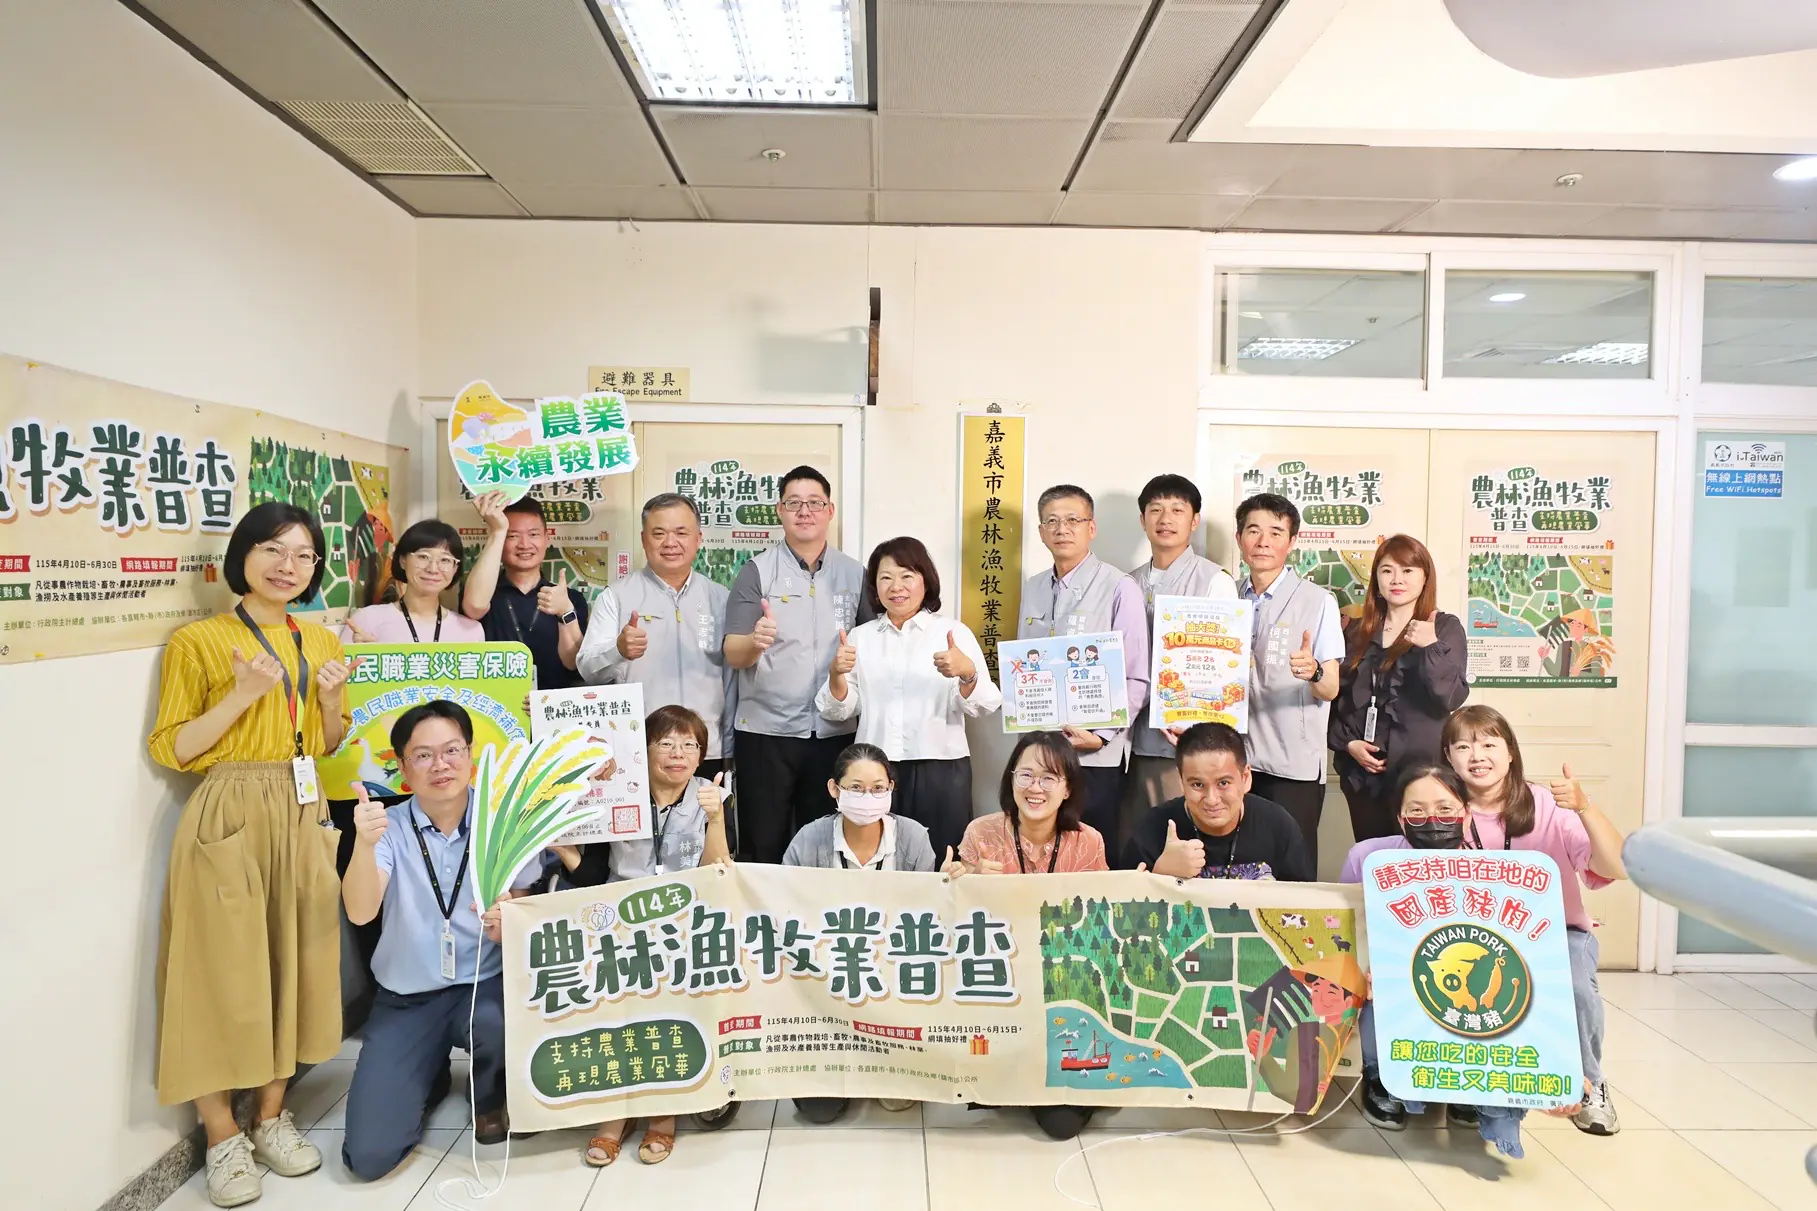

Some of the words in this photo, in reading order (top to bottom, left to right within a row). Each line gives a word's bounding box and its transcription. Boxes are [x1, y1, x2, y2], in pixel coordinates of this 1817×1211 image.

[602, 371, 675, 387] 避難器具
[643, 387, 682, 396] Equipment
[540, 396, 625, 438] 農業
[477, 436, 632, 482] 永續發展
[0, 424, 235, 527] 牧業普查
[1706, 472, 1781, 484] 無線上網熱點
[1472, 475, 1610, 509] 農林漁牧業
[1491, 507, 1528, 531] 普查
[36, 559, 117, 569] 115年4月10日~6月30日
[980, 420, 1005, 681] 嘉義市農林漁牧業普查
[1021, 673, 1038, 685] 3不
[544, 700, 631, 720] 農林漁牧業普查
[1374, 856, 1550, 892] 請支持咱在地的
[625, 885, 685, 920] 114年
[1420, 927, 1466, 958] TAIWAN
[1469, 927, 1509, 957] PORK
[529, 906, 1014, 1013] 農林漁牧業普查
[767, 1017, 849, 1027] 115年4月10日~6月30日
[858, 1023, 915, 1039] 網路填報期間
[550, 1024, 684, 1065] 支持農業普查
[1391, 1040, 1540, 1068] 讓您吃的安全
[556, 1053, 689, 1092] 再現農業風華
